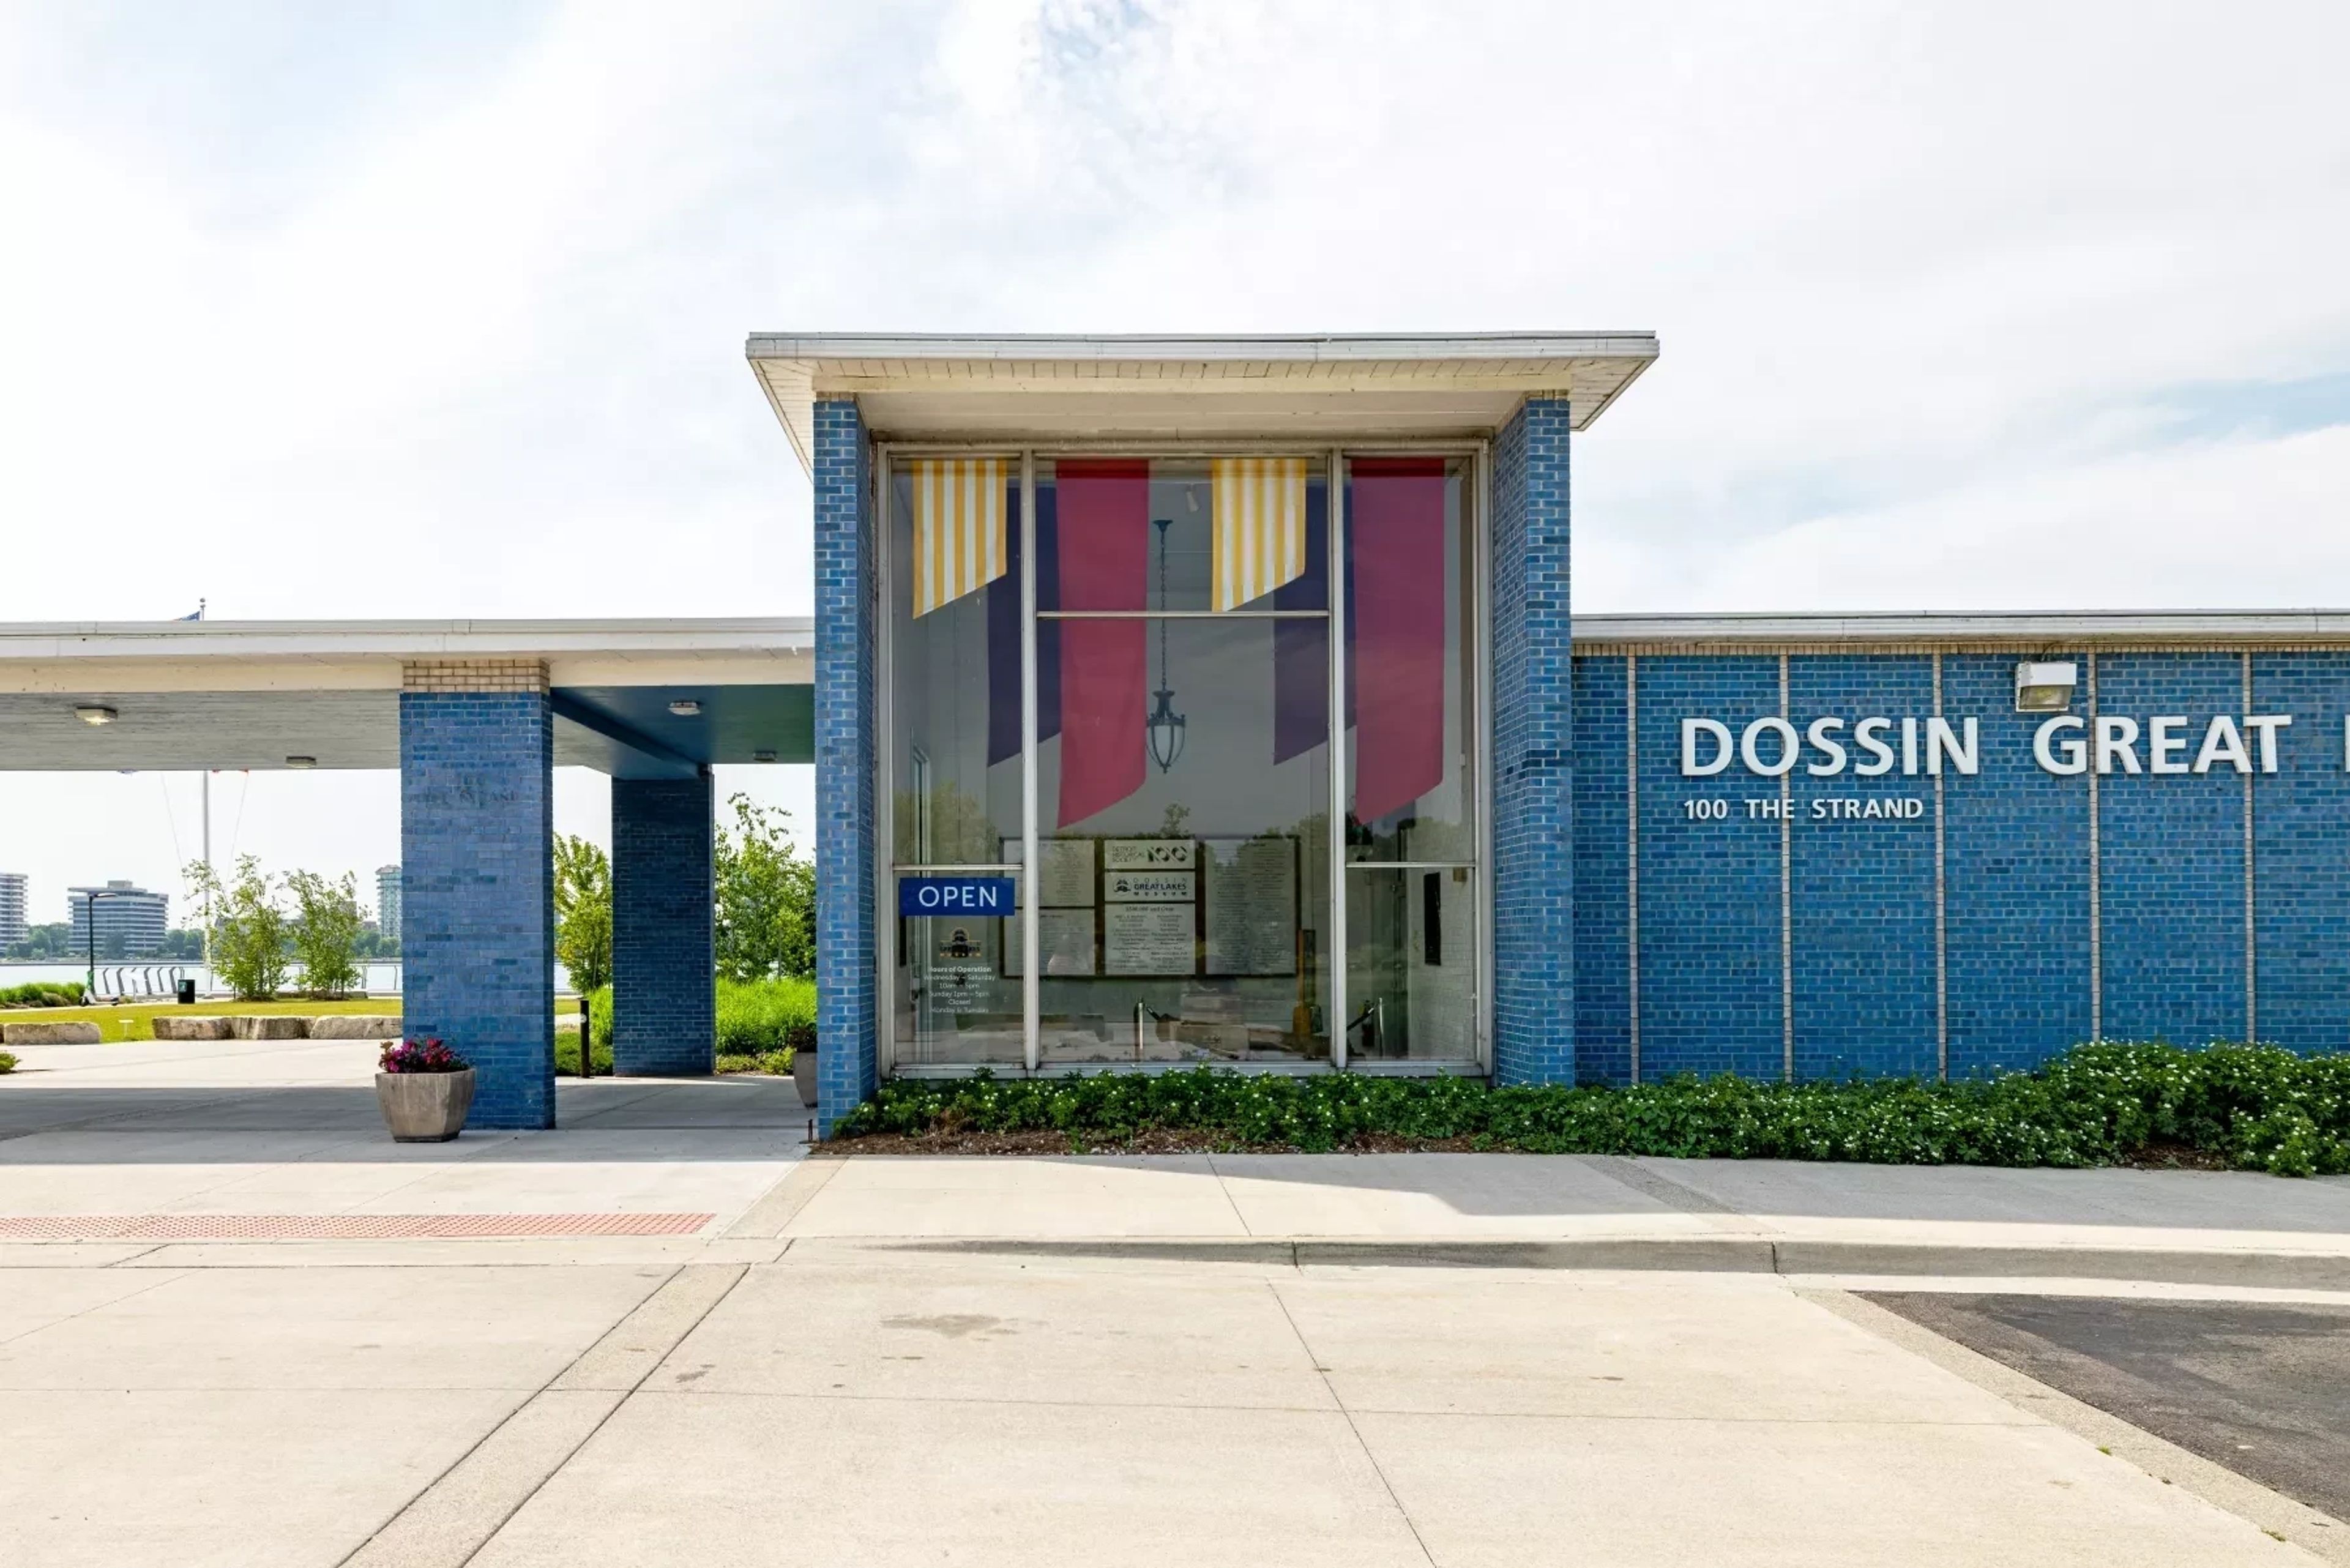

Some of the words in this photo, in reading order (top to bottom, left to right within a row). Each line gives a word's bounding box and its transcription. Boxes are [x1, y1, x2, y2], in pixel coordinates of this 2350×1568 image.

[1682, 717, 1979, 776] DOSSIN
[2032, 715, 2292, 775] GREAT
[1684, 799, 1728, 819] 100
[1745, 799, 1795, 819] THE
[1812, 798, 1923, 819] STRAND
[919, 886, 997, 907] OPEN
